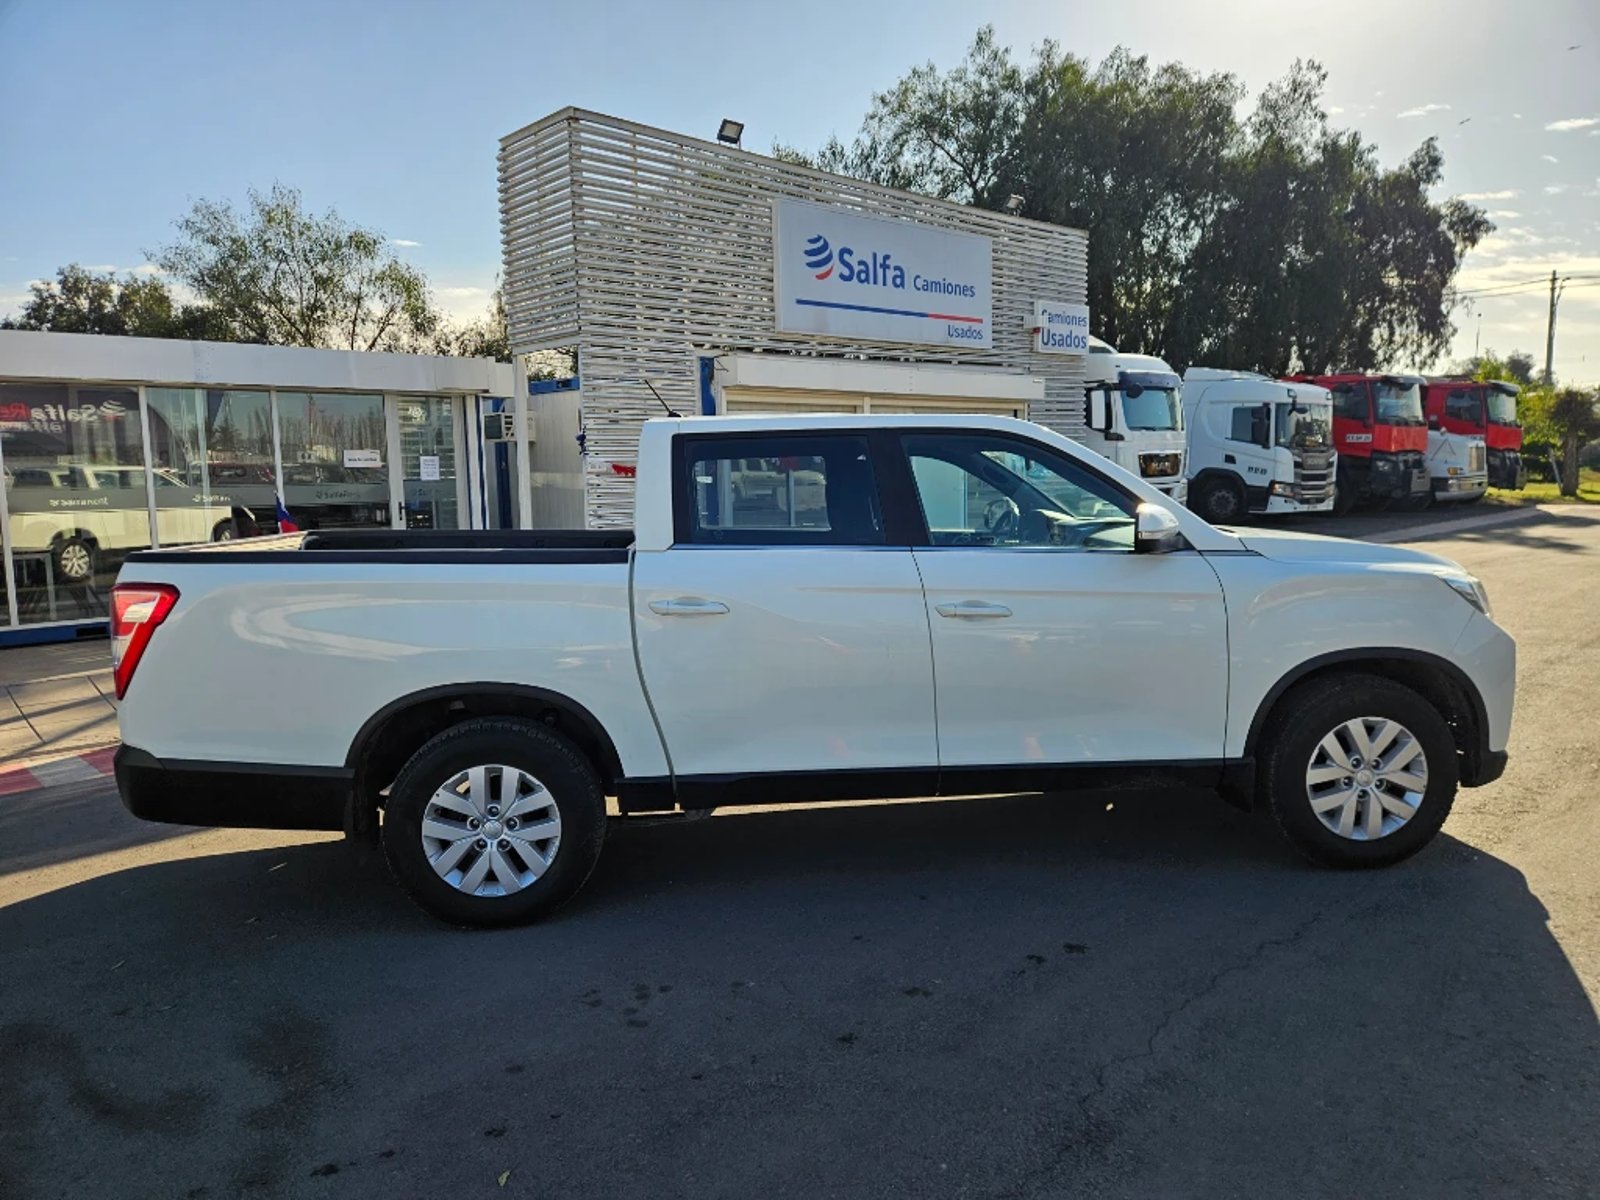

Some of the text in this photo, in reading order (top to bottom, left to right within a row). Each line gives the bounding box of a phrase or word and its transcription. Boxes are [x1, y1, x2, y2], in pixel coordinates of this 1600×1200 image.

[838, 246, 976, 298] Salfa Camiones
[947, 324, 984, 340] Usados
[1041, 327, 1087, 349] Usados
